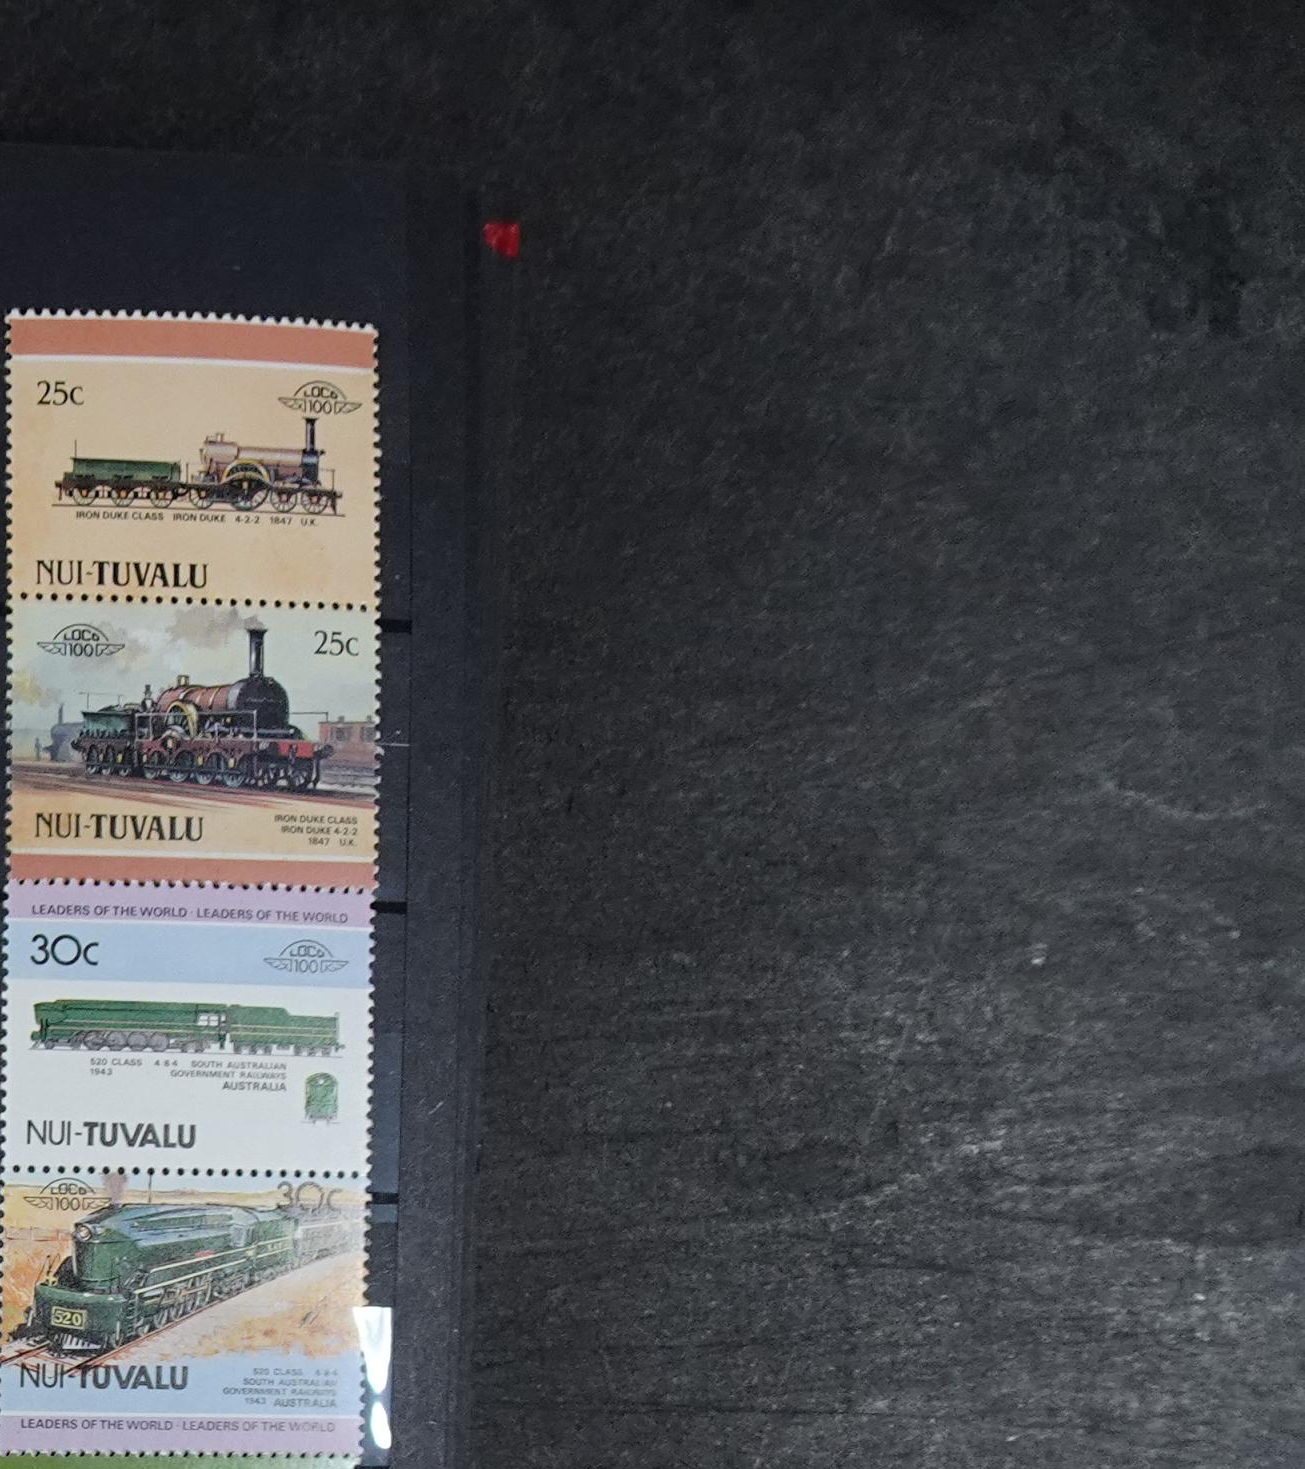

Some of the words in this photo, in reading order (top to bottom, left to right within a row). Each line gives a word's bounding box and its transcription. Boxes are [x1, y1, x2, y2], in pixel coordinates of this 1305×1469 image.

[36, 381, 85, 406] 25c
[75, 511, 100, 520] IRON
[102, 511, 130, 521] DUKE
[132, 511, 164, 521] CLASS
[269, 516, 292, 526] 1847
[313, 630, 360, 657] 25c
[30, 934, 99, 967] 30c
[222, 1081, 287, 1092] AUSTRALIA
[276, 1181, 342, 1212] 30c
[53, 1310, 83, 1326] 520
